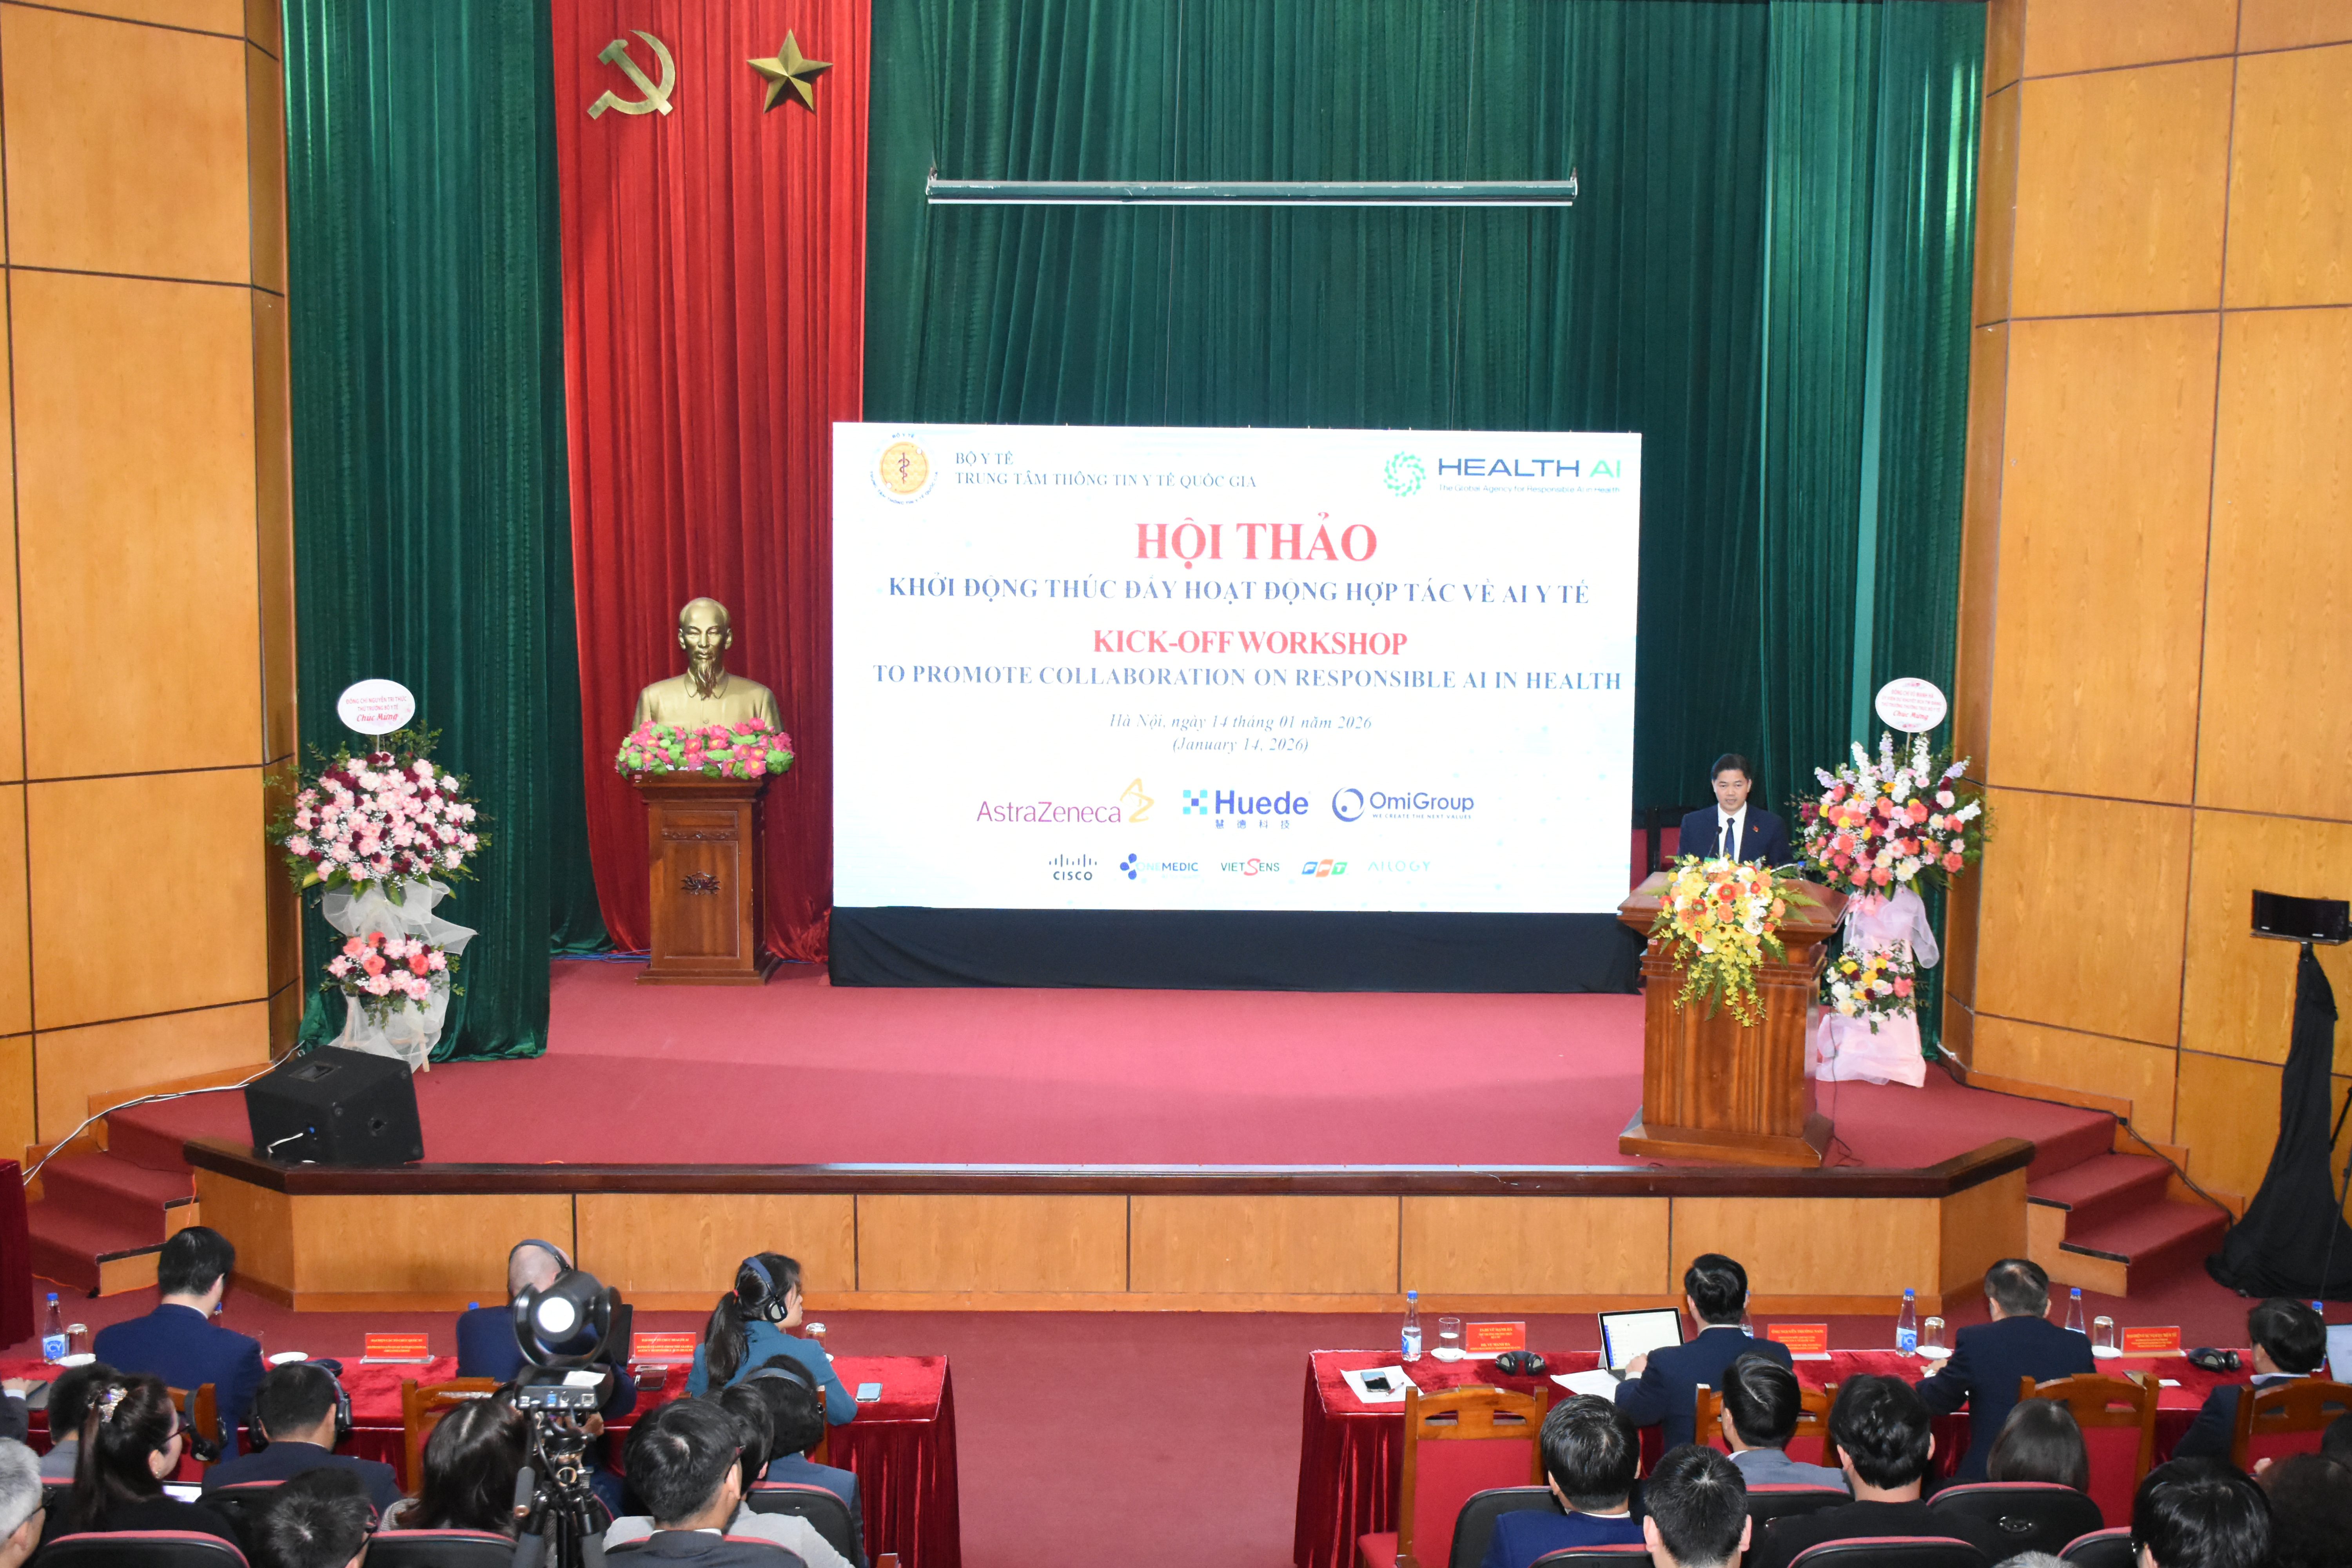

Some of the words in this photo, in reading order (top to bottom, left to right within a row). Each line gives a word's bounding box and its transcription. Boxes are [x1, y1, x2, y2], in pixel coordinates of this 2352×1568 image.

[956, 451, 977, 467] BỘ
[981, 453, 990, 465] Y
[1438, 458, 1580, 477] HEALTH
[1589, 459, 1621, 478] AI
[956, 472, 1007, 485] TRUNG
[1013, 470, 1047, 485] TÂM
[1054, 470, 1107, 486] THÔNG
[1112, 474, 1137, 486] TIN
[1143, 475, 1152, 486] Y
[1229, 475, 1256, 487] GIA
[1439, 484, 1450, 492] The
[1454, 484, 1481, 493] Global
[1483, 485, 1512, 494] Agency
[1527, 485, 1575, 494] Responsible
[1135, 517, 1223, 570] HỘI
[1236, 512, 1377, 562] THẢO
[890, 572, 955, 597] KHỞI
[965, 575, 1037, 603] ĐỘNG
[1045, 573, 1116, 599] THÚC
[1185, 581, 1257, 605] HOẠT
[1265, 579, 1337, 606] ĐỘNG
[1346, 581, 1398, 607] HỢP
[1404, 577, 1455, 603] TÁC
[1502, 584, 1527, 603] AI
[1536, 585, 1551, 603] Y
[1094, 630, 1234, 654] KICK-OFF
[1238, 631, 1408, 656] WORKSHOP
[873, 665, 905, 682] TO
[913, 665, 1033, 684] PROMOTE
[1039, 667, 1245, 686] COLLABORATION
[1254, 669, 1287, 686] ON
[1296, 669, 1455, 688] RESPONSIBLE
[1463, 671, 1486, 688] AI
[1495, 671, 1517, 689] IN
[1526, 672, 1620, 690] HEALTH
[1110, 714, 1131, 727] Hà
[1137, 714, 1165, 730] Nội,
[1171, 715, 1206, 731] ngày
[1213, 715, 1228, 728] 14
[1232, 715, 1274, 732] tháng
[1279, 716, 1294, 728] 01
[1301, 716, 1332, 729] năm
[1338, 716, 1372, 729] 2026
[1173, 737, 1237, 755] (January
[1244, 738, 1263, 751] 14,
[1269, 737, 1308, 752] 2026)
[1215, 789, 1309, 815] Huede
[1369, 791, 1475, 812] OmiGroup
[976, 800, 1121, 823] AstraZeneca
[1053, 870, 1093, 881] CISCO
[1220, 858, 1280, 877] VIETSENS
[1302, 861, 1347, 875] FPT
[47, 1343, 62, 1352] ICY
